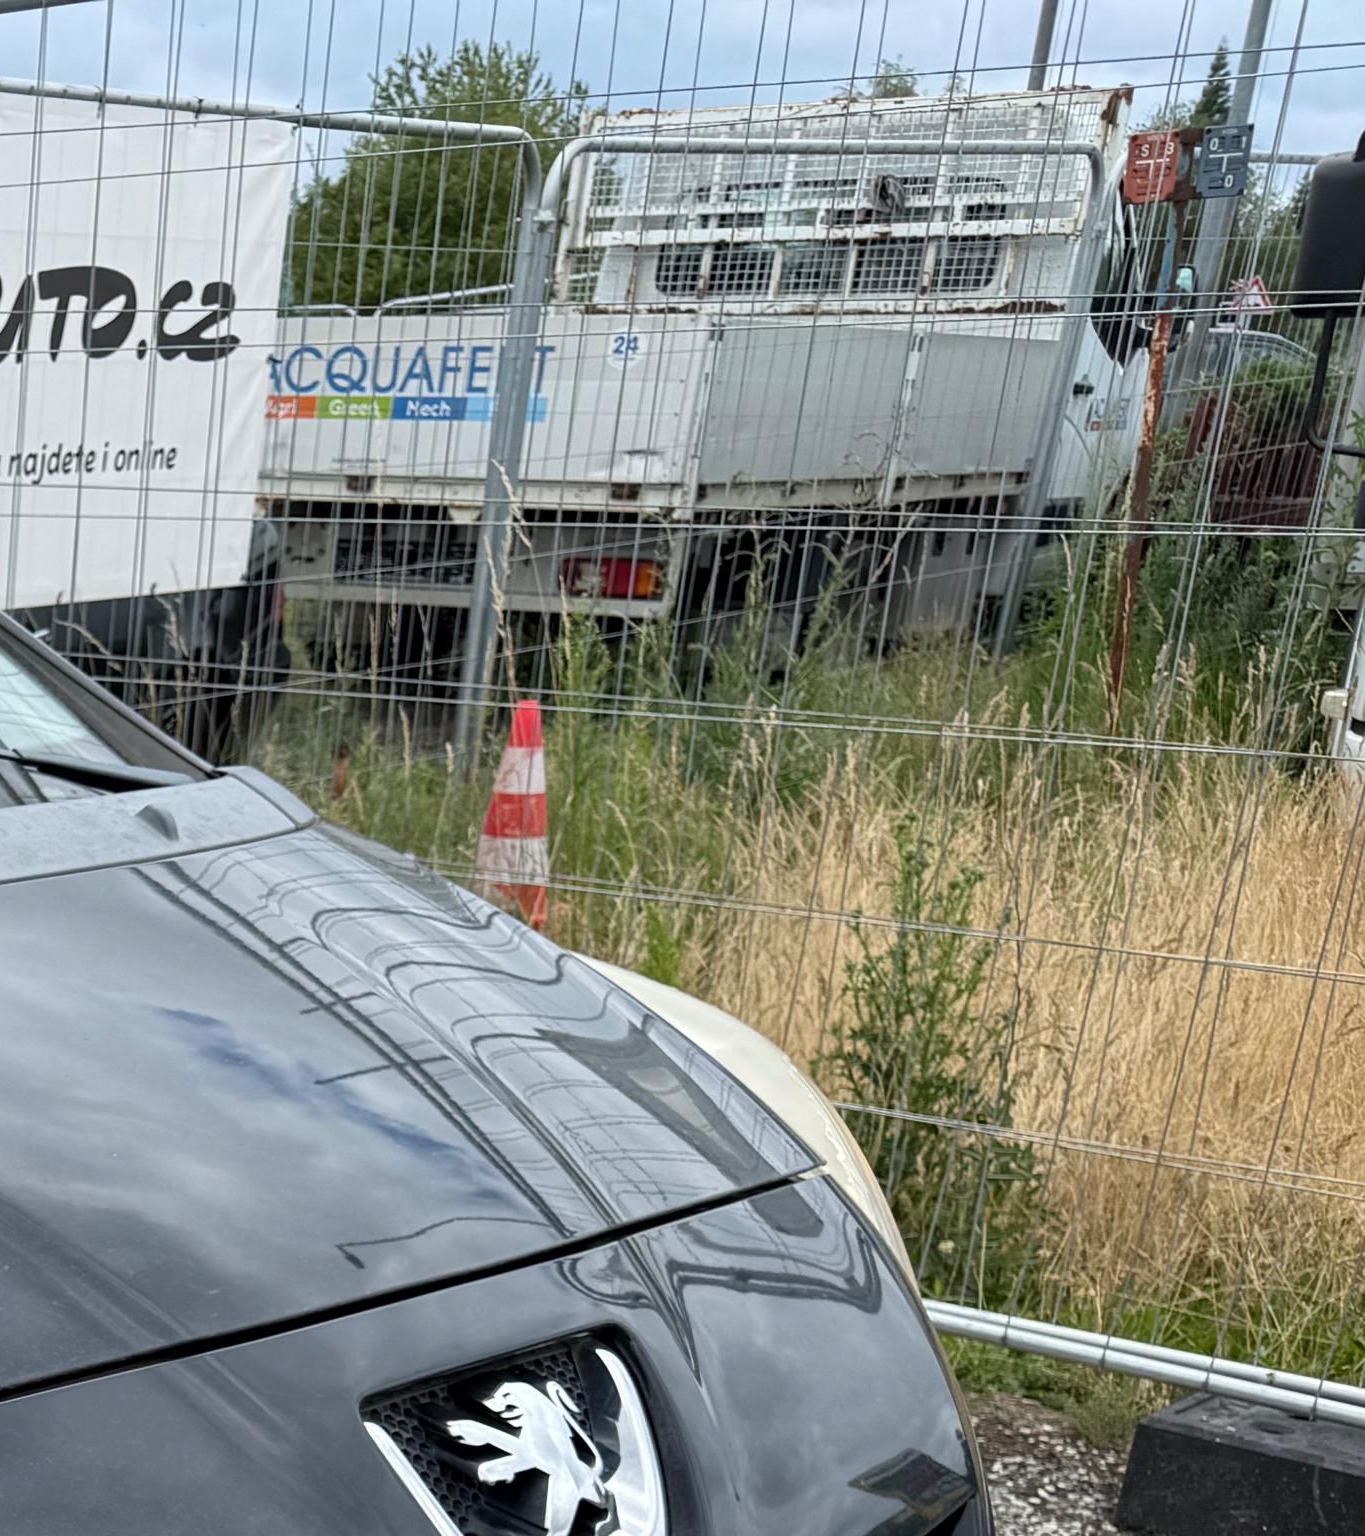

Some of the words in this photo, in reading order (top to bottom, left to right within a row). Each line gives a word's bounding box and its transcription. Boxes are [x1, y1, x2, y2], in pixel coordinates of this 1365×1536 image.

[268, 345, 556, 394] CQUAFET
[8, 443, 95, 485] najdete
[101, 441, 110, 472] i
[114, 440, 178, 472] online
